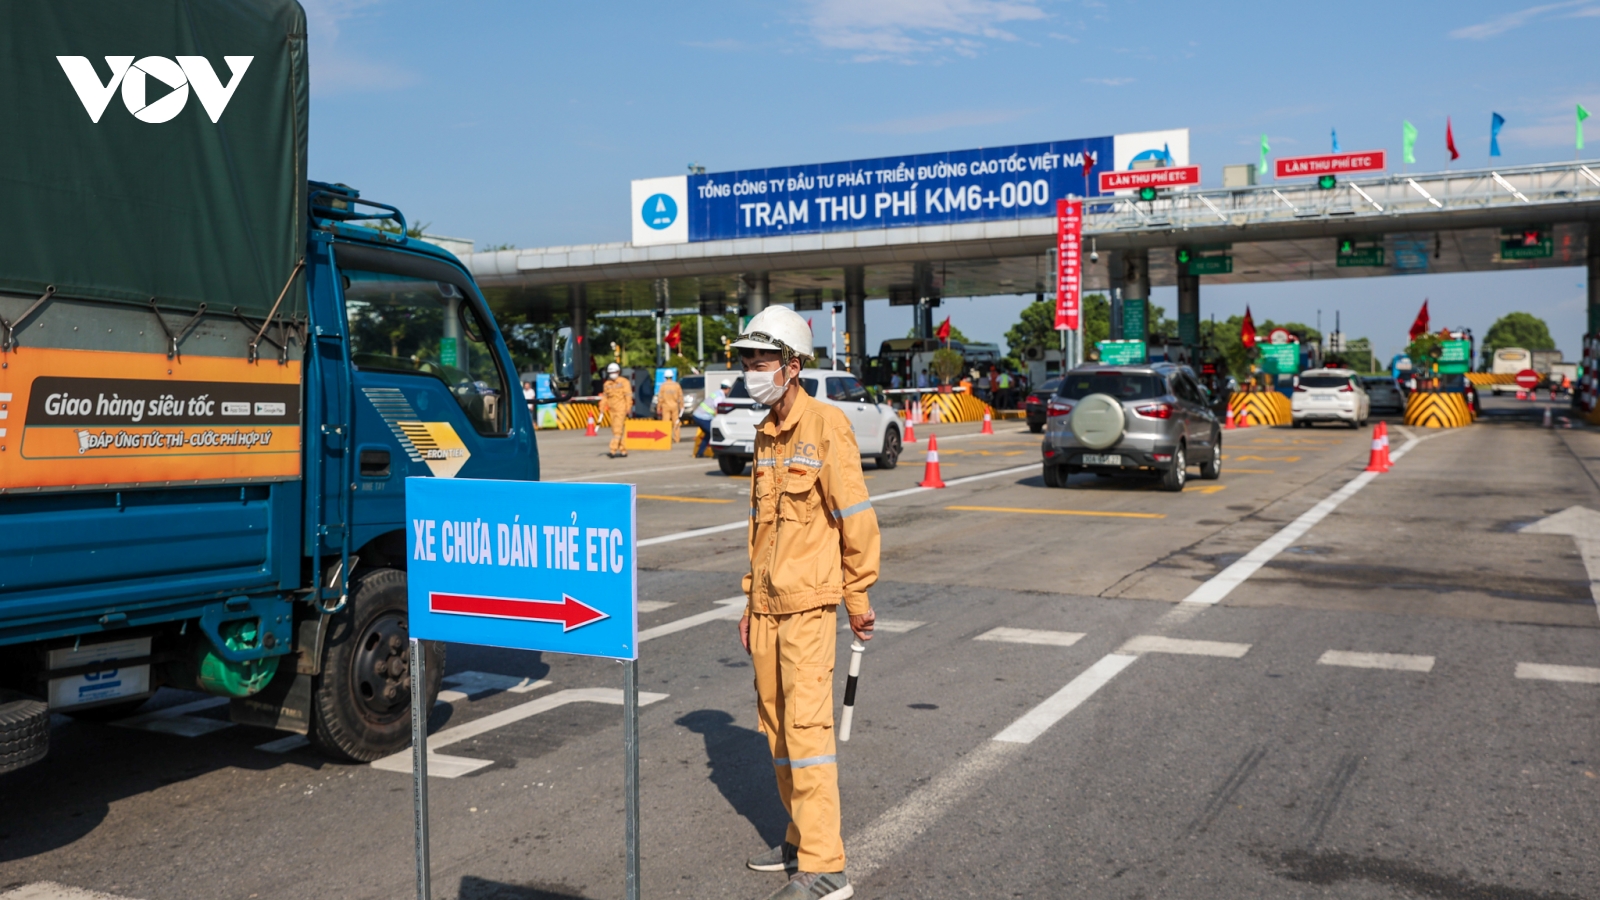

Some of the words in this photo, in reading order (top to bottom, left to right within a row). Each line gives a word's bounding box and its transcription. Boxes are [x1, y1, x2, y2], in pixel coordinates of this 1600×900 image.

[698, 180, 731, 199] TỔNG
[733, 179, 767, 196] CÔNG
[769, 179, 785, 193] TY
[787, 172, 814, 191] ĐẦU
[816, 174, 835, 189] TƯ
[837, 169, 873, 187] PHÁT
[875, 162, 914, 183] TRIỂN
[917, 161, 967, 181] ĐƯỜNG
[970, 162, 998, 176] CAO
[998, 153, 1027, 174] TỐC
[1028, 152, 1060, 172] VIỆT
[1285, 160, 1308, 173] LÀN
[1309, 160, 1330, 171] THU
[1331, 156, 1350, 169] PHÍ
[1350, 156, 1372, 168] ETC
[1109, 173, 1130, 186] LÀN
[1130, 174, 1150, 184] THU
[1151, 170, 1168, 183] PHÍ
[1168, 171, 1187, 182] ETC
[740, 199, 809, 230] TRẠM
[815, 194, 867, 223] THU
[875, 183, 918, 218] PHÍ
[925, 179, 1049, 214] KM6+000
[44, 393, 92, 416] Giao
[96, 393, 146, 422] hàng
[148, 394, 185, 416] siêu
[187, 394, 215, 416] tốc
[88, 430, 114, 448] ĐÁP
[114, 429, 141, 448] ỨNG
[141, 429, 165, 447] TỨC
[165, 429, 184, 447] THÌ
[189, 429, 220, 447] CƯỚC
[219, 429, 239, 446] PHÍ
[238, 429, 260, 449] HỢP
[260, 429, 273, 445] LÝ
[427, 448, 465, 459] FRONTIER
[413, 519, 437, 561] XE
[441, 517, 493, 566] CHƯA
[497, 515, 538, 568] DÁN
[543, 511, 580, 571] THẺ
[586, 527, 624, 574] ETC
